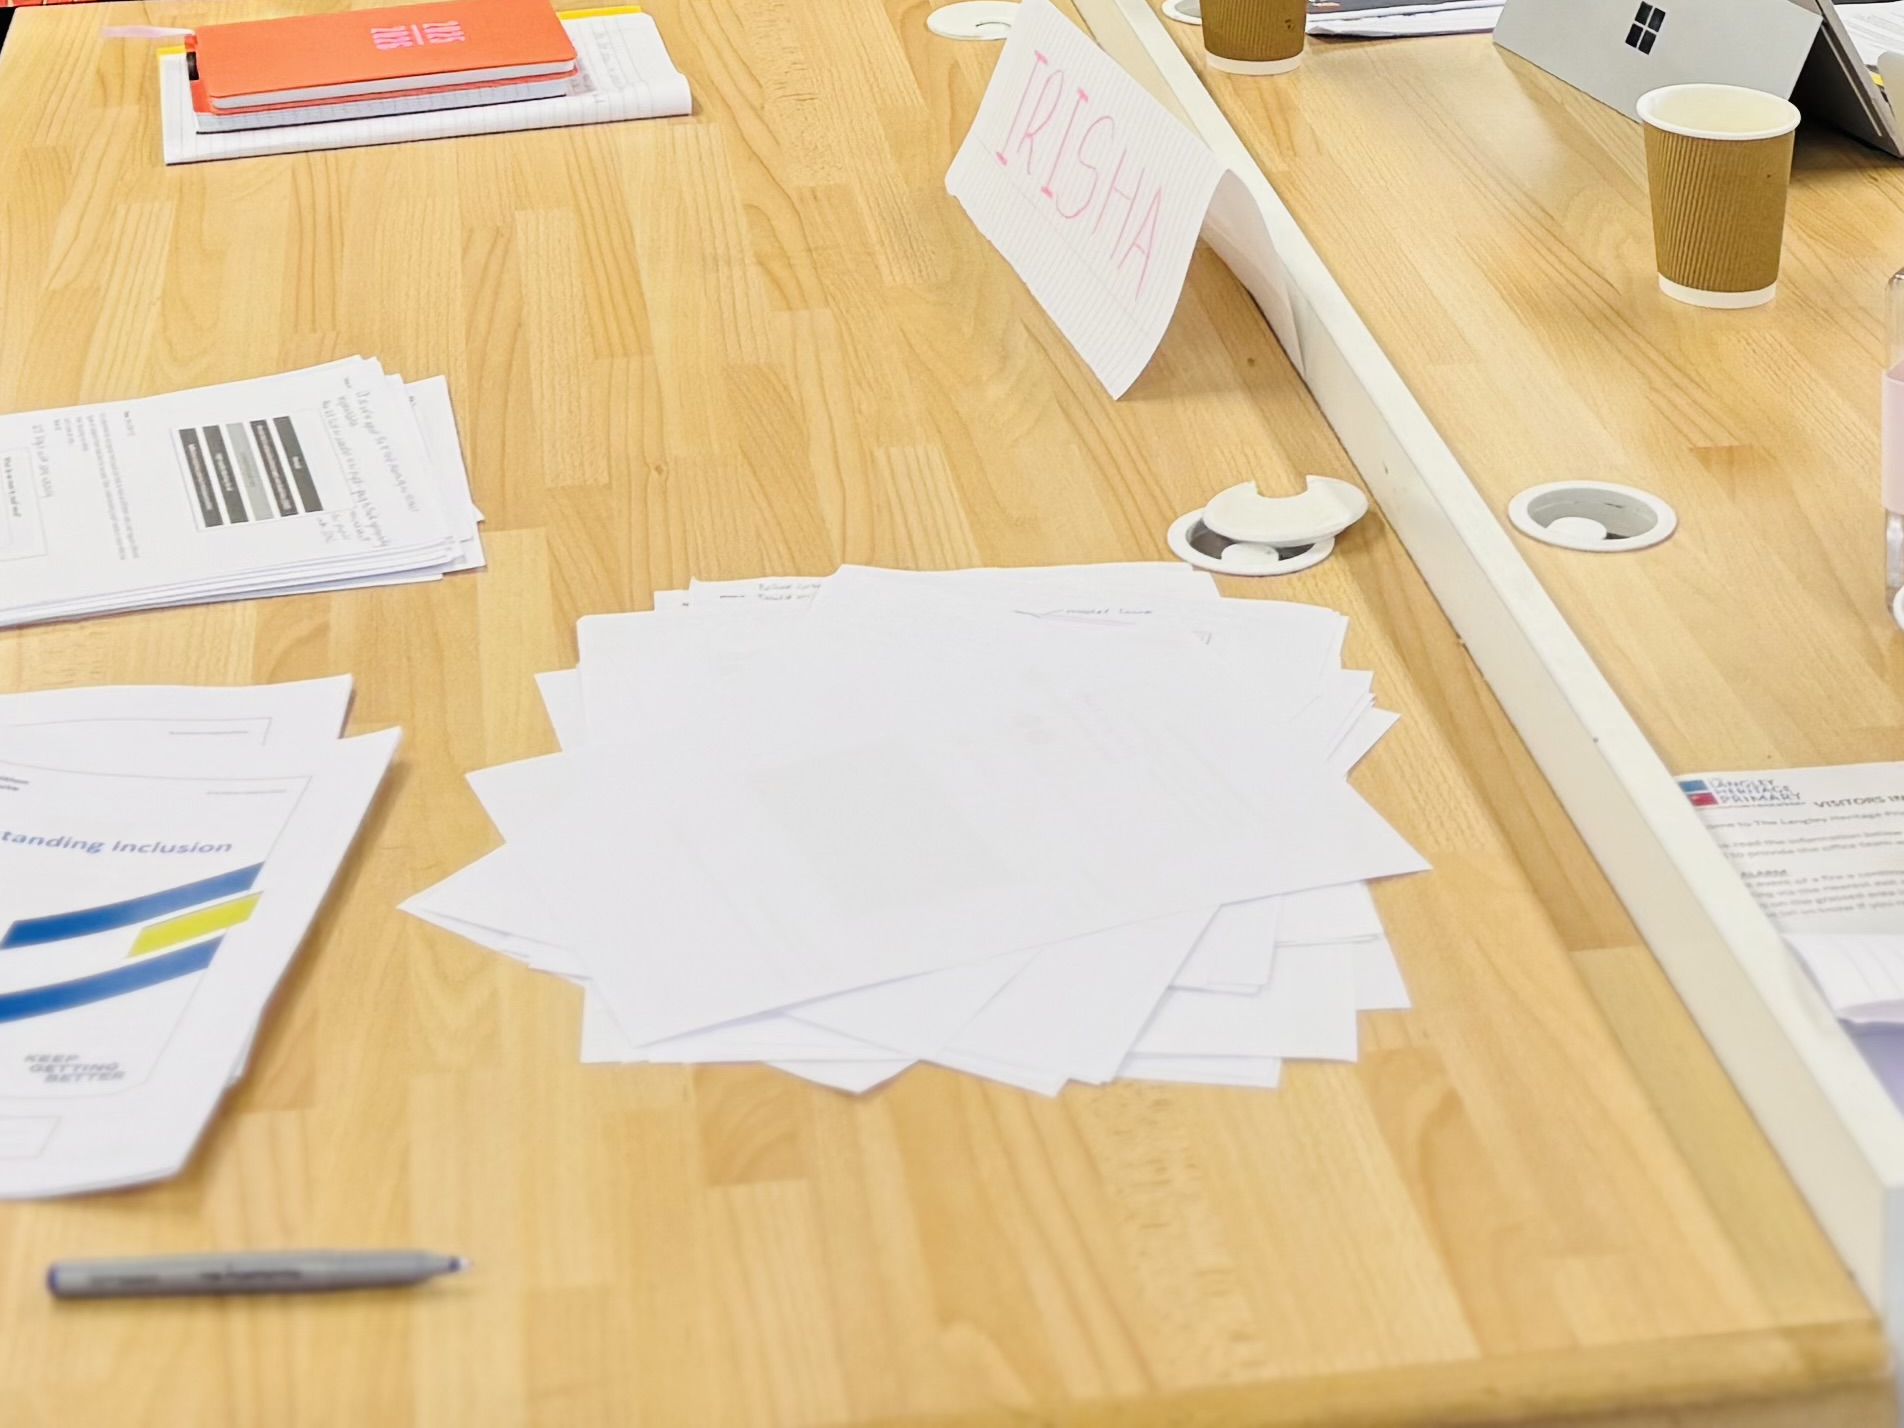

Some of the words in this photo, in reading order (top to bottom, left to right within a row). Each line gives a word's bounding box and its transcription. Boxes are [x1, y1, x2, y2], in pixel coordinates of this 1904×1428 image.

[1719, 792, 1802, 804] PRIMARY
[1813, 795, 1884, 809] VISITORS
[112, 839, 233, 855] Inclusion
